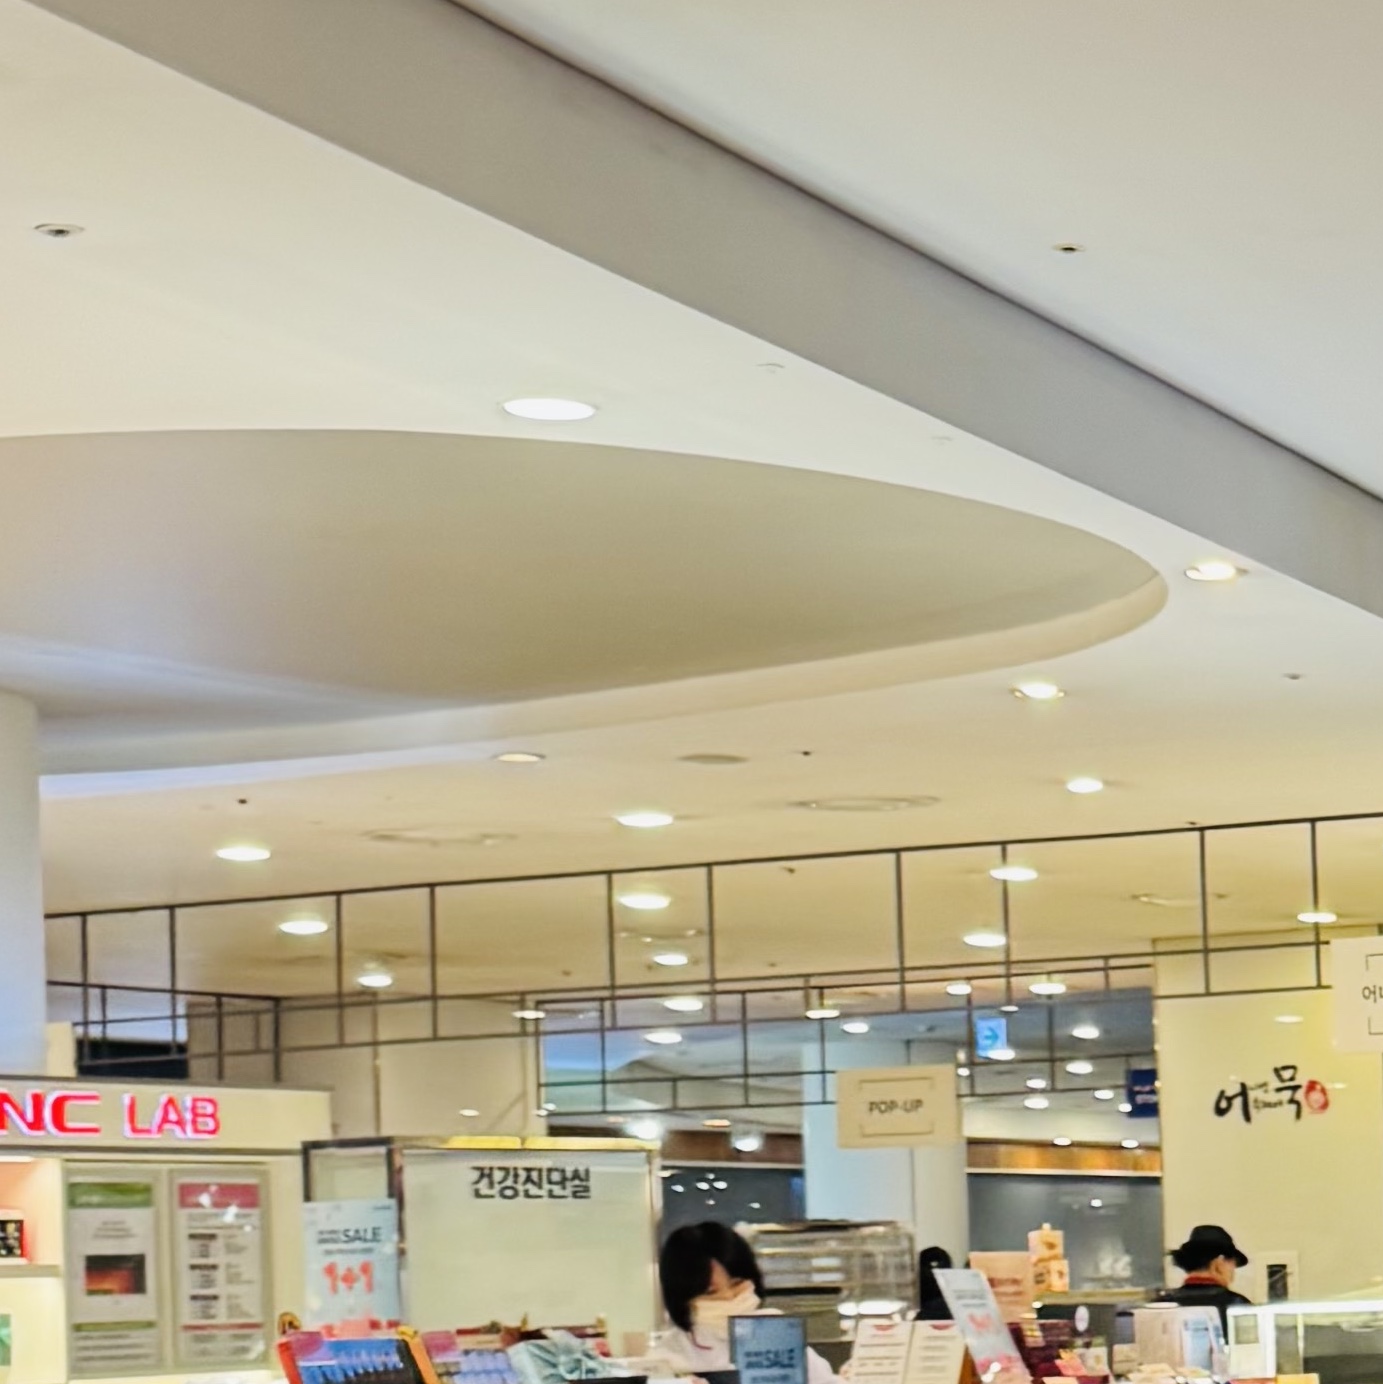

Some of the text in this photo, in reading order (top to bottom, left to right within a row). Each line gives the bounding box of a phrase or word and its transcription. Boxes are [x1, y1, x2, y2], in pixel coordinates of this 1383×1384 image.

[122, 1092, 220, 1138] LAB
[868, 1098, 924, 1114] POP-UP
[470, 1166, 592, 1200] 건강진단실
[342, 1226, 383, 1244] SALE
[323, 1260, 375, 1294] 1+1
